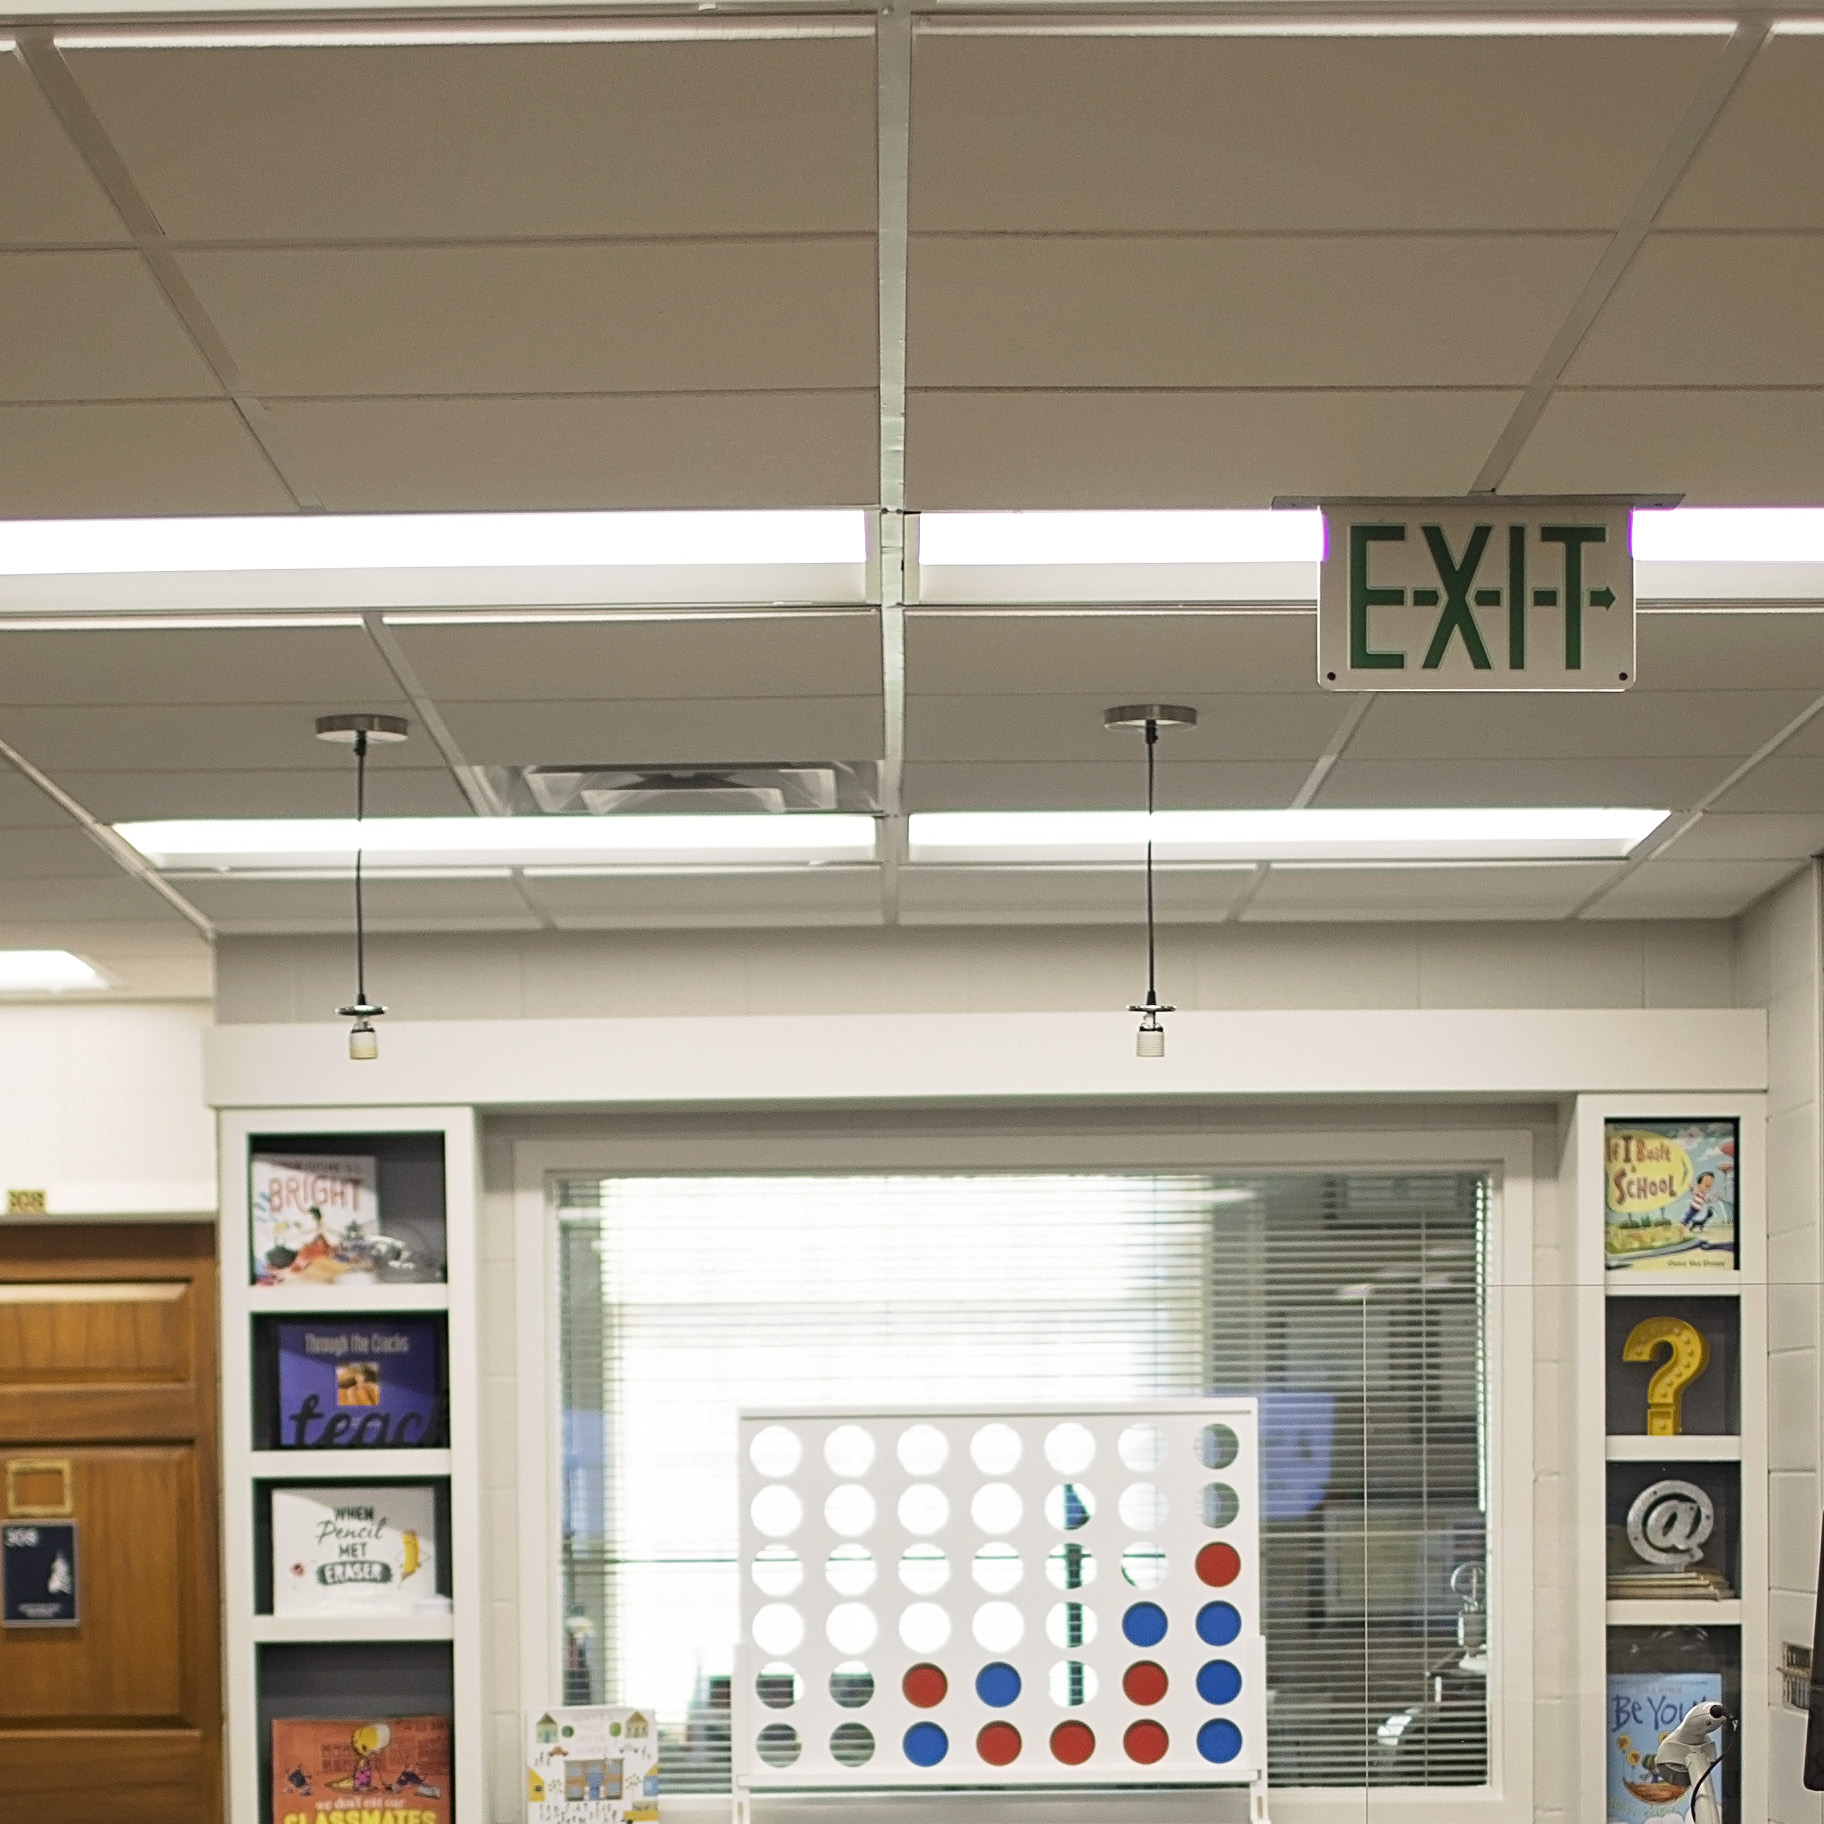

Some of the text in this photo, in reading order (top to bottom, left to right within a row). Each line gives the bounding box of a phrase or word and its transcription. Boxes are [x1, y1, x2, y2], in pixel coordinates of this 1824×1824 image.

[1349, 524, 1607, 670] EXIT
[268, 1174, 363, 1214] BRIGHT
[335, 1506, 375, 1521] WHEN
[316, 1516, 387, 1546] Pencil
[338, 1542, 368, 1558] MET
[324, 1563, 383, 1583] ERASER
[1612, 1694, 1644, 1732] Be
